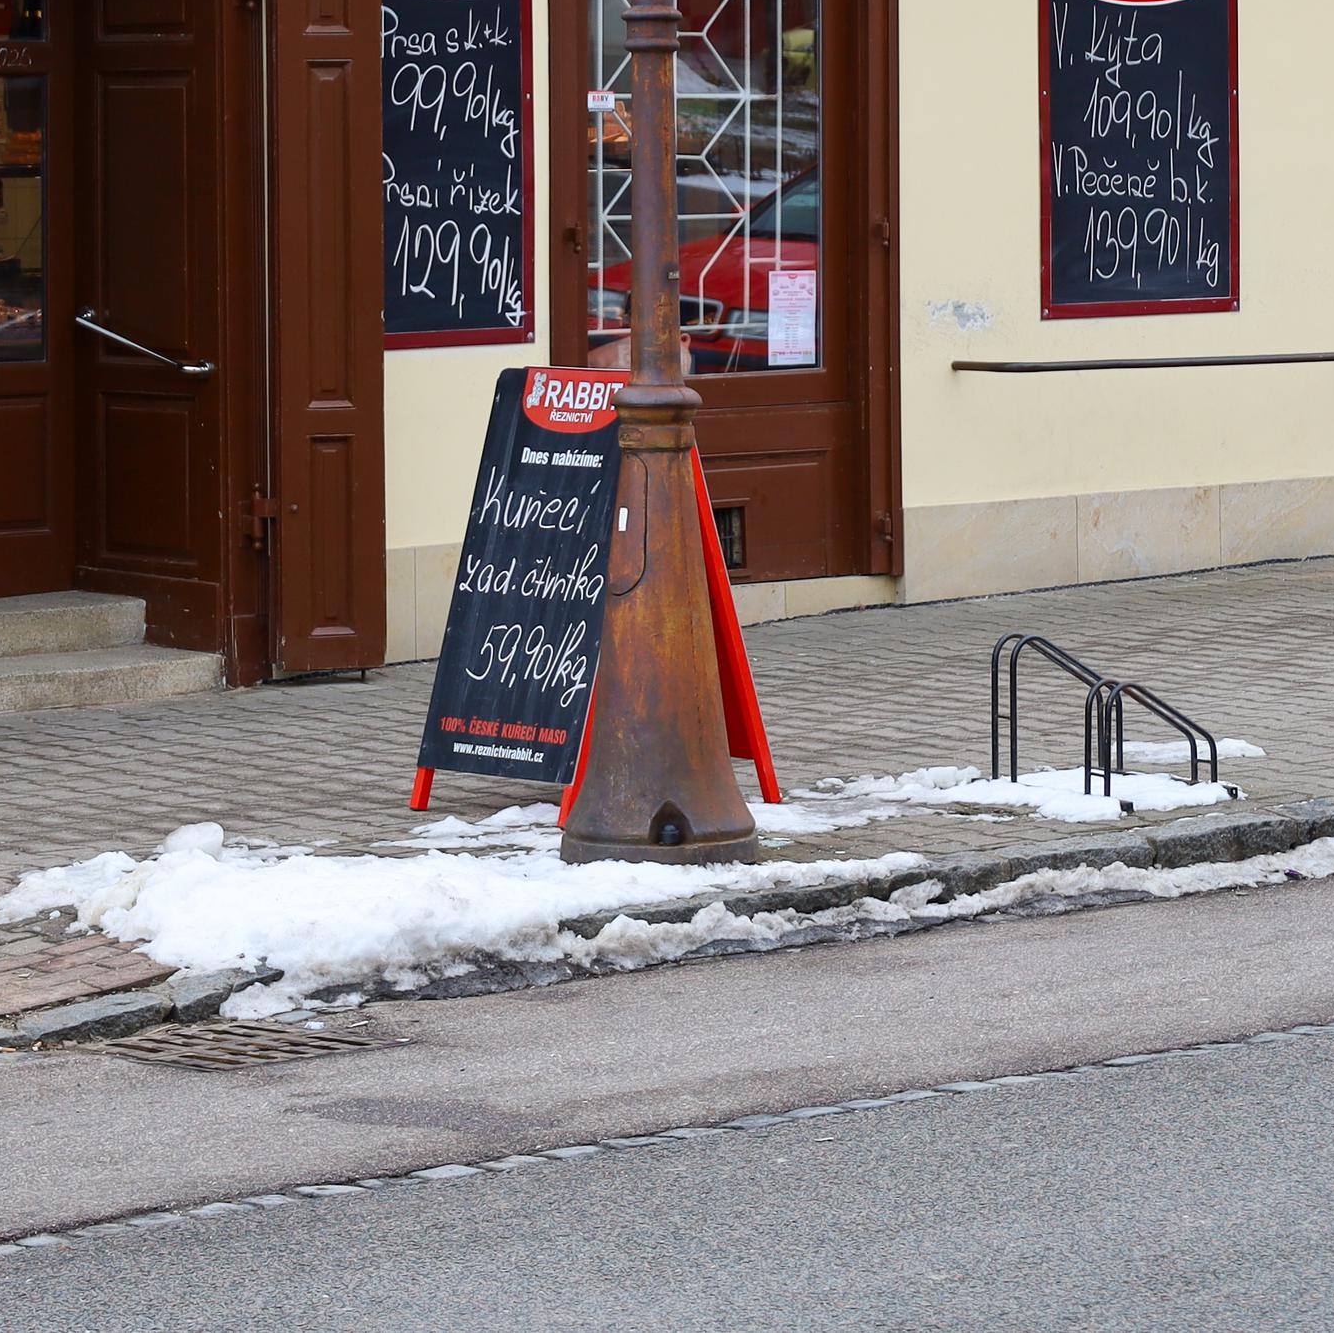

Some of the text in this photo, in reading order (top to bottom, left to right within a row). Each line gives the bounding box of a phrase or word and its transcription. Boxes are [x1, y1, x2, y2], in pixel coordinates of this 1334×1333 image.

[549, 409, 594, 423] ŘEZNICTVÍ
[521, 447, 604, 468] Dnes nabízíme:
[441, 715, 567, 745] 100% ČESKÉ KUŘECÍ MASO
[453, 741, 545, 763] www.reznictvirabbit.cz
